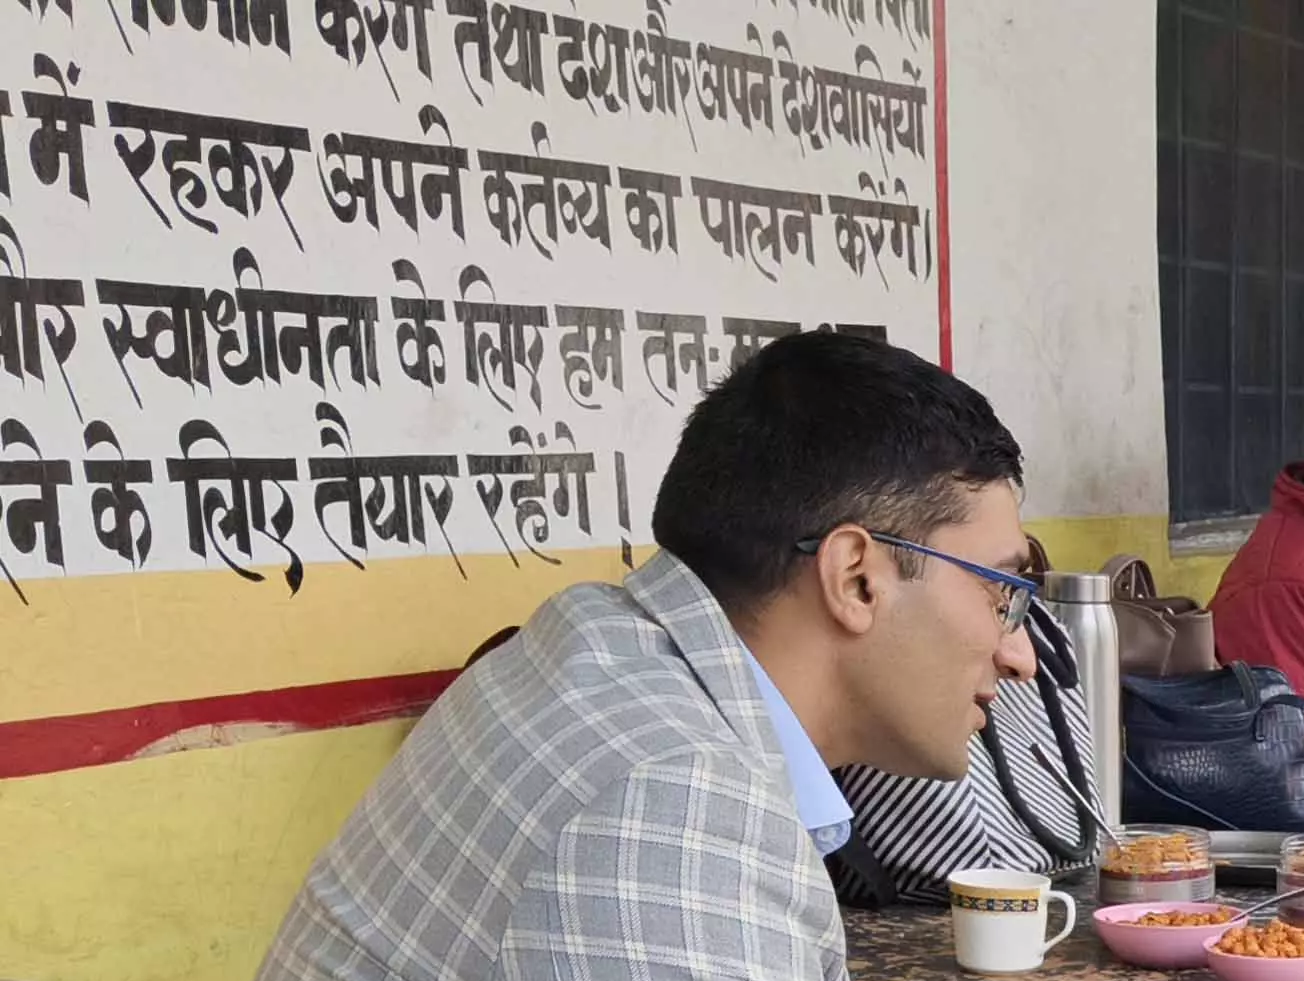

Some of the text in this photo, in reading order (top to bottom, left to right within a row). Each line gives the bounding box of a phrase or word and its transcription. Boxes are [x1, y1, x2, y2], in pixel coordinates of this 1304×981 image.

[446, 0, 548, 106] तथा
[22, 53, 96, 206] में
[106, 101, 311, 252] रहकर
[316, 104, 469, 242] अपने
[477, 121, 611, 261] कर्तव्य
[618, 166, 681, 255] का
[691, 176, 823, 282] पालन
[96, 246, 380, 409] स्वाधीनता
[391, 258, 446, 392] के
[455, 264, 548, 413] लिए
[555, 304, 624, 409] हम
[83, 420, 152, 570] के
[166, 419, 303, 598] लिए
[308, 402, 467, 579] तैयार
[467, 421, 595, 567] रहेंगे
